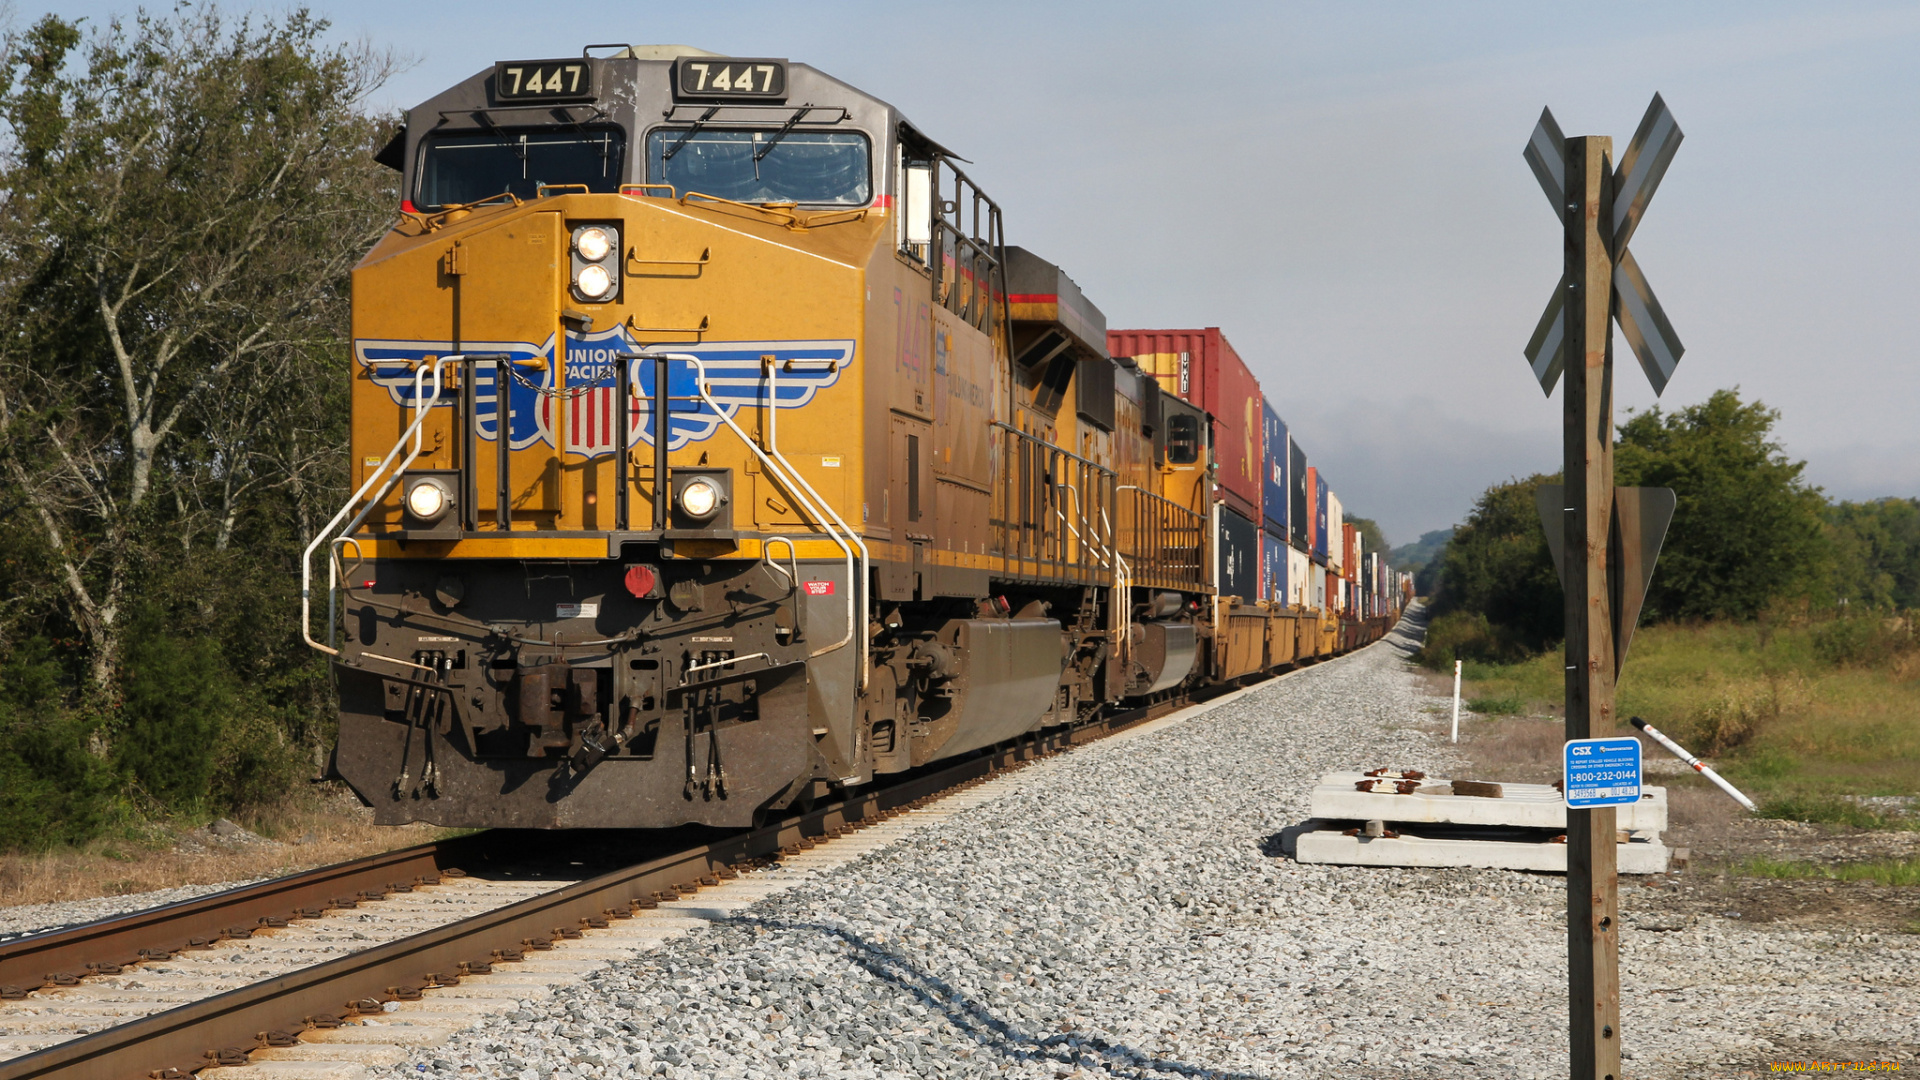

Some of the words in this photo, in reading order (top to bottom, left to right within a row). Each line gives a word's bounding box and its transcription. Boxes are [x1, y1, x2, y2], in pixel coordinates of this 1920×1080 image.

[506, 65, 582, 95] 7447
[691, 64, 775, 92] 7447
[565, 349, 621, 363] UNION
[1572, 746, 1592, 756] CSX
[1570, 770, 1636, 782] 1-800-232-0144
